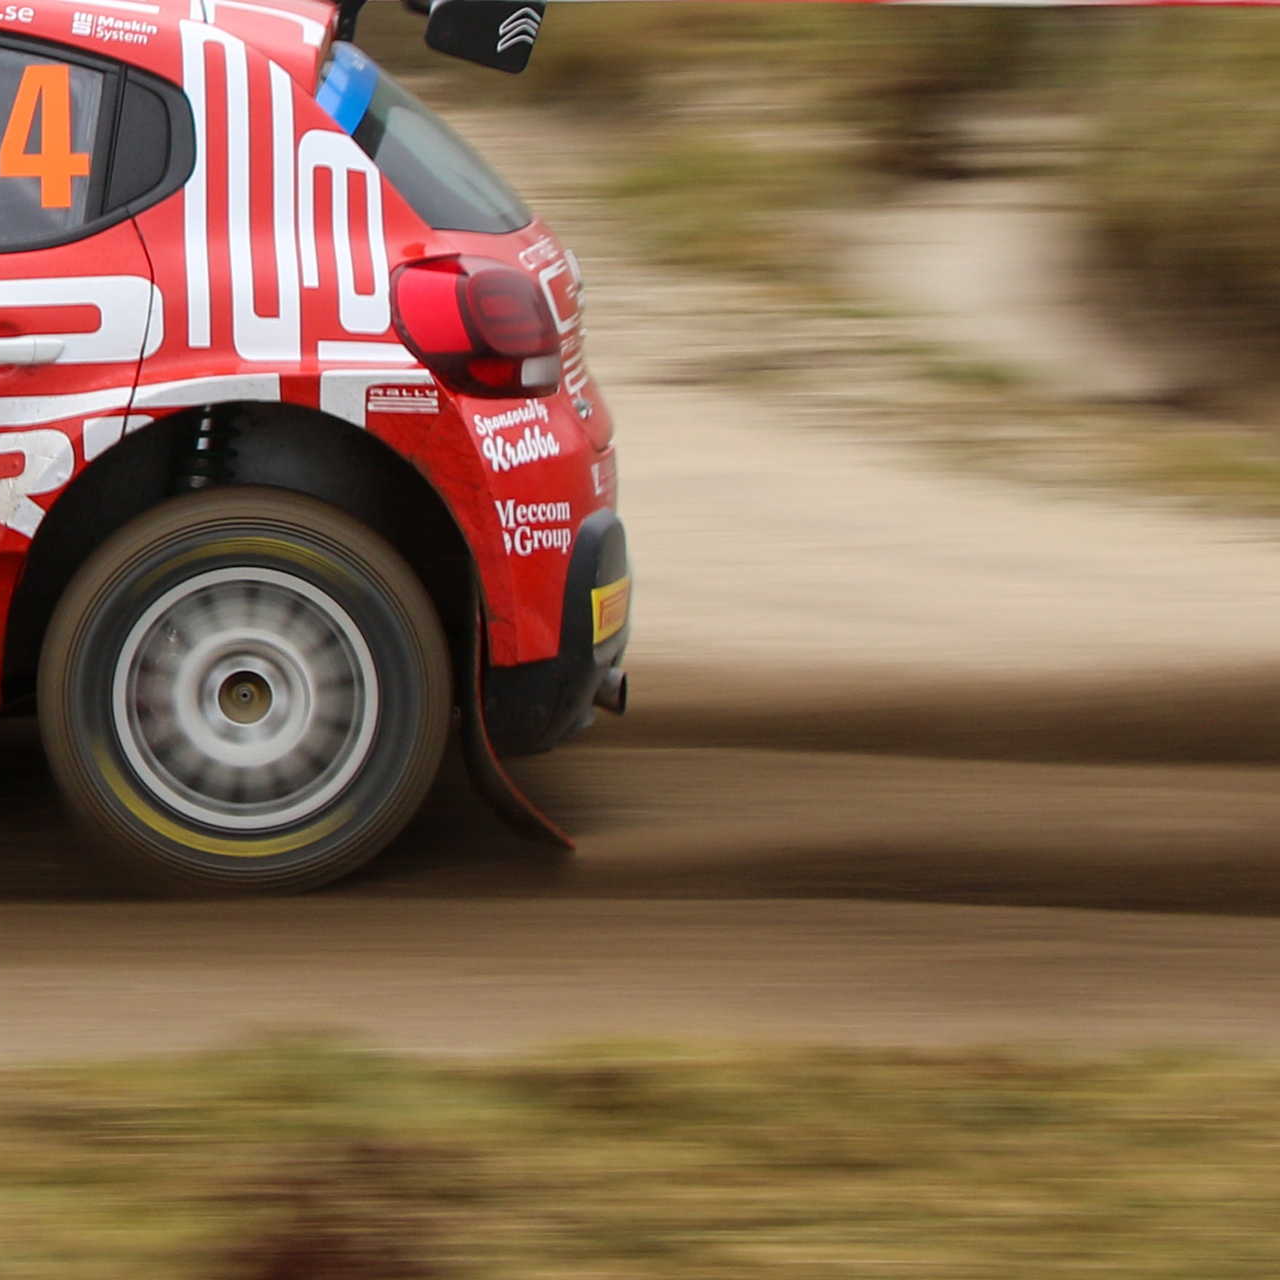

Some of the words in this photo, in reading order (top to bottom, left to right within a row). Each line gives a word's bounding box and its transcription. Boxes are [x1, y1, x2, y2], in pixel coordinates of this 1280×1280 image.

[95, 26, 148, 45] System
[97, 15, 158, 35] Maskin
[483, 424, 561, 473] Krabba
[513, 525, 572, 557] Group
